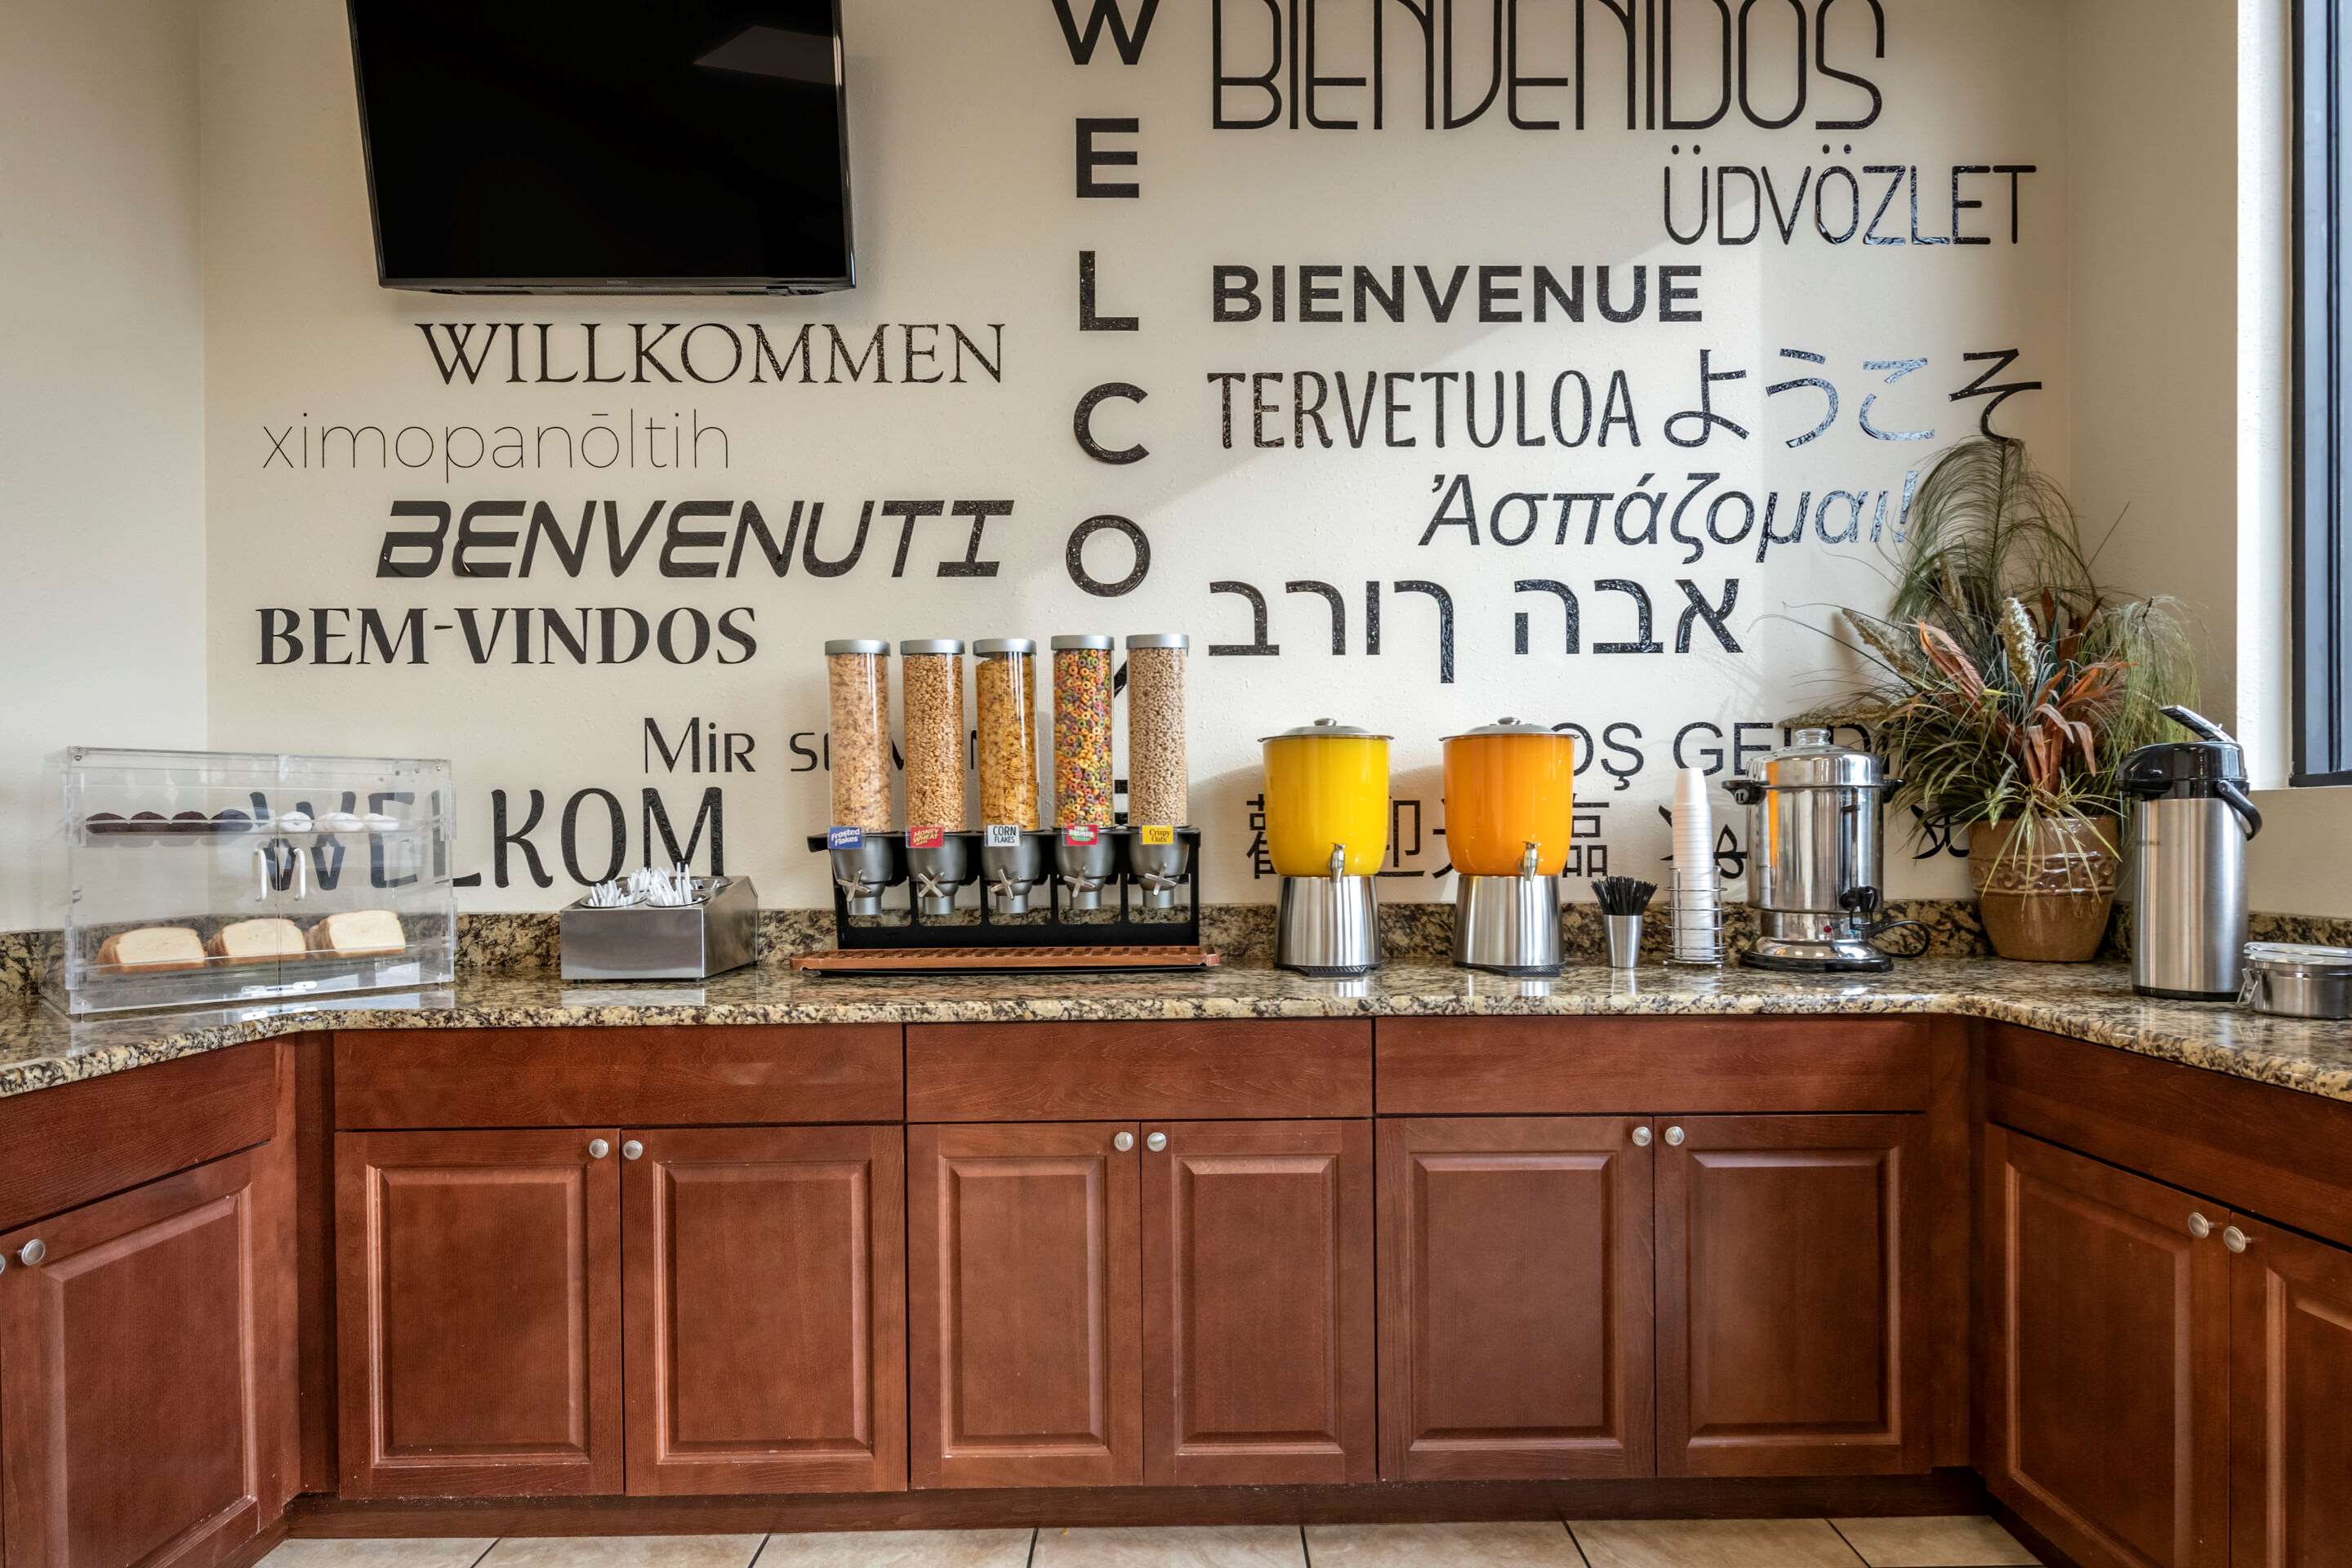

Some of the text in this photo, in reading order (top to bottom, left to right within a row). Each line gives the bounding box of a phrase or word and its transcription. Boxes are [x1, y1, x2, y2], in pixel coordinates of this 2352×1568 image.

[1664, 144, 2038, 246] ÜDVÖZLET
[1212, 264, 1704, 324] BIENVENUE
[415, 323, 1005, 385] WILLKOMMEN
[1207, 370, 1642, 449] TERVETULOA
[1663, 349, 2042, 448] ようこそ
[261, 410, 729, 483] ximopanōltih
[376, 499, 1015, 579] BENVENUTI
[255, 606, 758, 667] BEM-VINDOS
[248, 786, 725, 892] WELKOM
[831, 828, 861, 842] Frosted
[835, 835, 859, 846] Flakes
[913, 834, 939, 844] WHEAT
[914, 828, 940, 837] HONEY
[992, 826, 1017, 836] CORN
[994, 835, 1015, 844] FLAKES
[1149, 829, 1170, 838] Crispy
